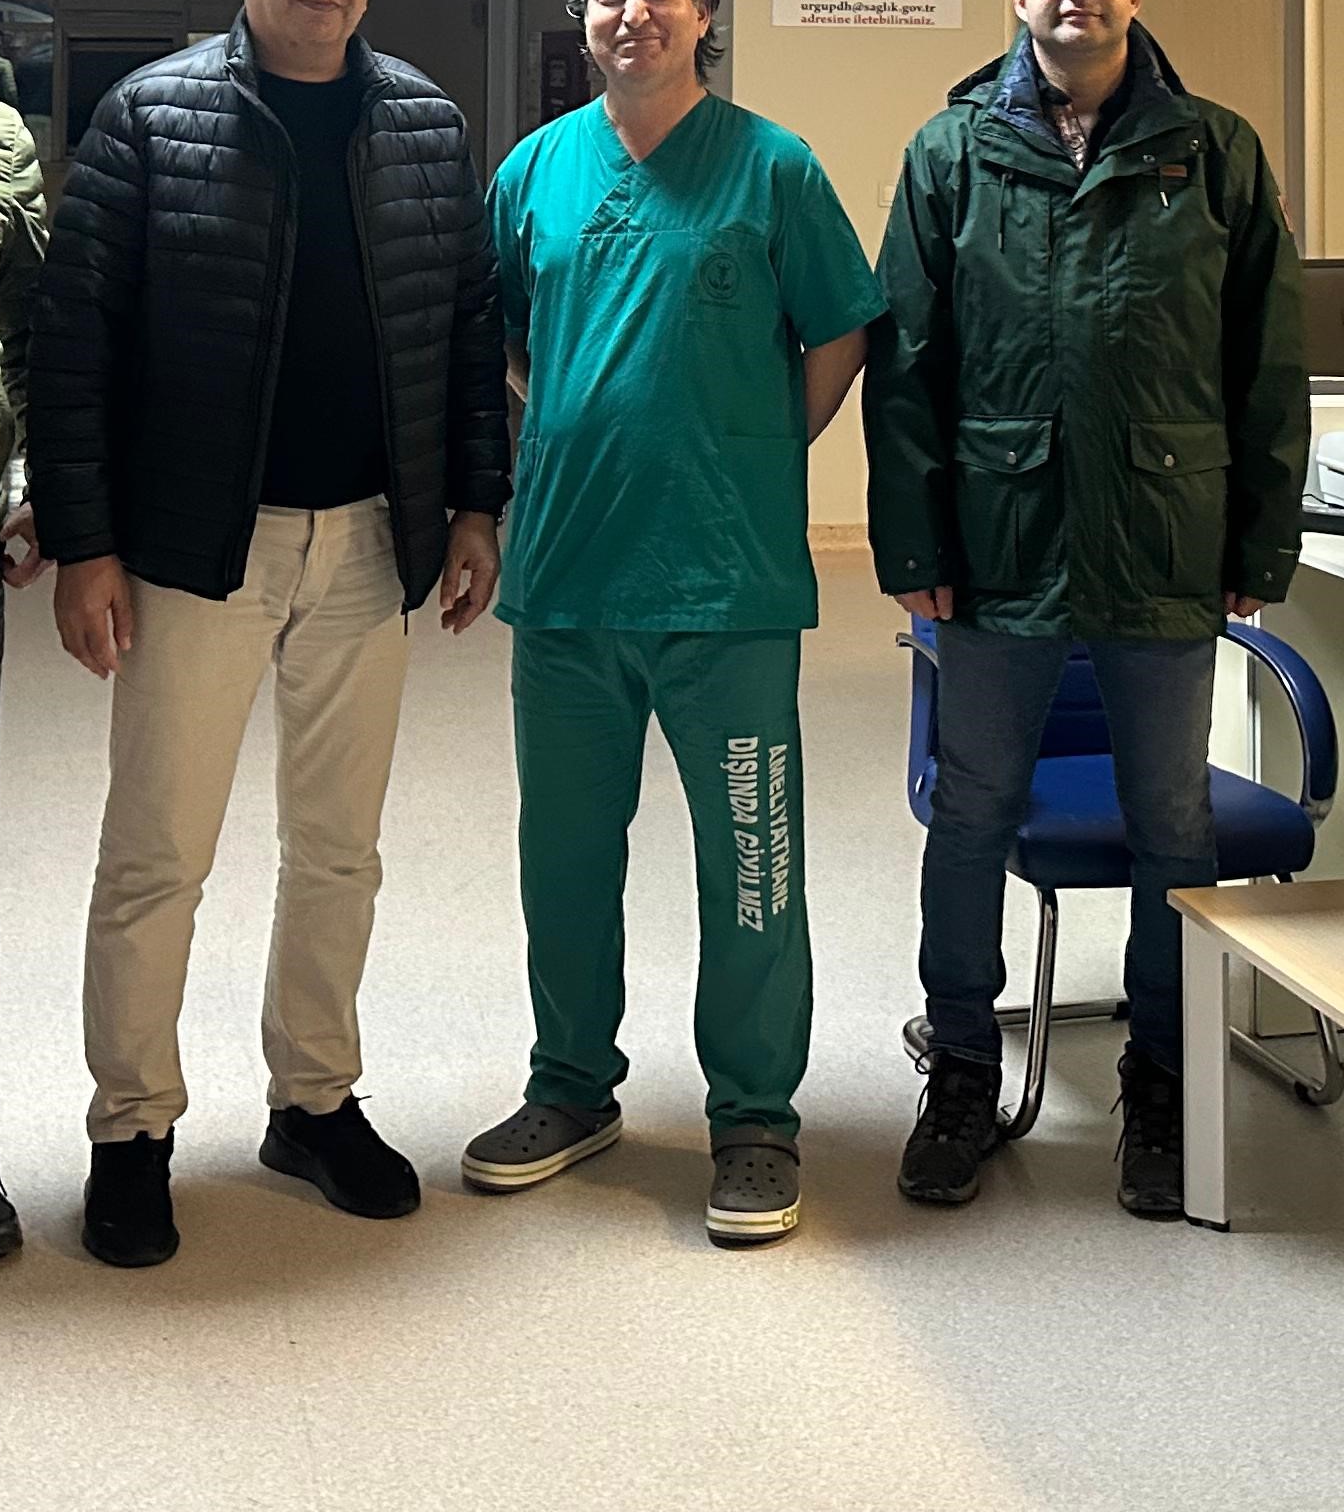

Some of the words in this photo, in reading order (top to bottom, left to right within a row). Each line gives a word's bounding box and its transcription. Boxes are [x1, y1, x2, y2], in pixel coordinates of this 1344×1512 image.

[800, 14, 851, 25] adresine
[720, 737, 758, 824] DIŞINDA
[768, 744, 790, 915] AMELİYATHANE
[734, 829, 766, 931] GİYİLMEZ
